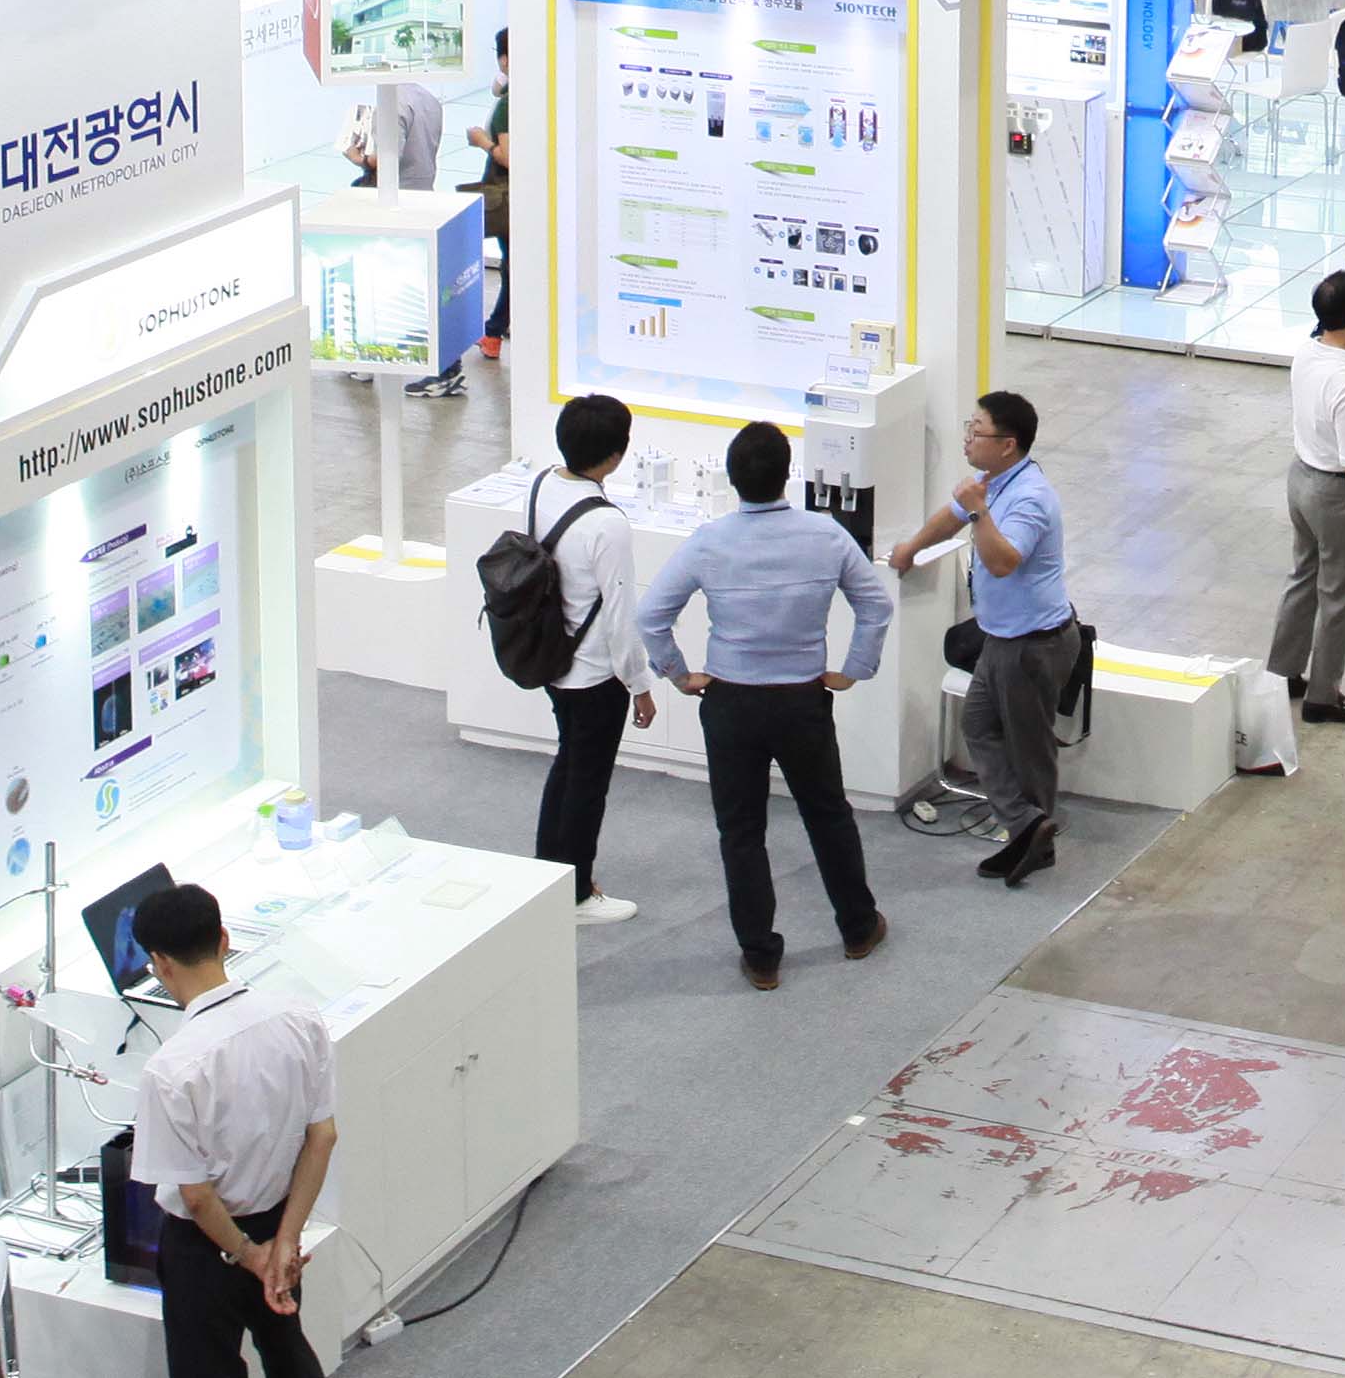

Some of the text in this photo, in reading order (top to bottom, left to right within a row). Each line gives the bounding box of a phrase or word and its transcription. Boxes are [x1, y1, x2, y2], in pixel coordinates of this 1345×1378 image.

[833, 0, 897, 18] SIONTECH
[1, 80, 200, 193] 대전광역시
[2, 141, 200, 224] DAEJEON METROPOLITAN CITY
[138, 277, 241, 337] SOPHUSTONE
[19, 342, 293, 484] http://www.sophustone.com
